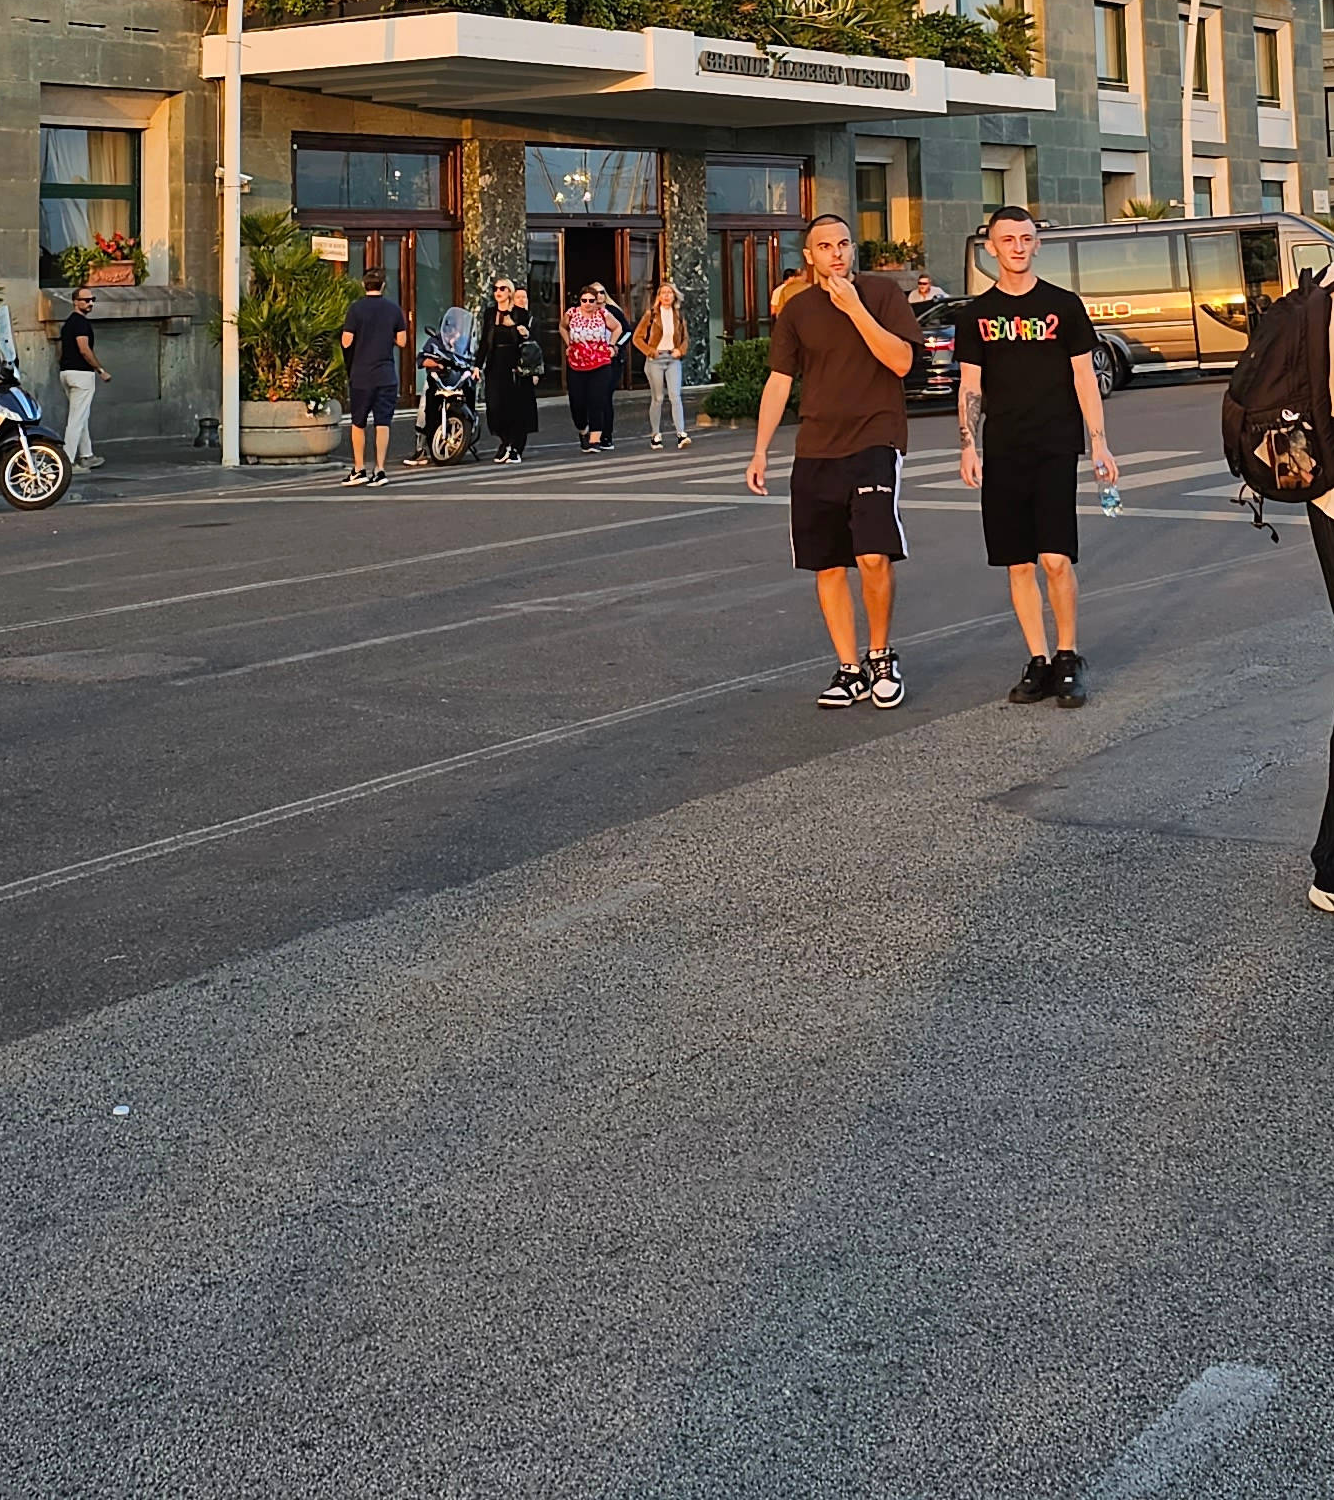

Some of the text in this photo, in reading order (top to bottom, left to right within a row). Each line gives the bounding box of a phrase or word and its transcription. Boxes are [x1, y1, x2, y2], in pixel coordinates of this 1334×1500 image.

[700, 50, 911, 91] GRANDE ALBERGO VESUVIO
